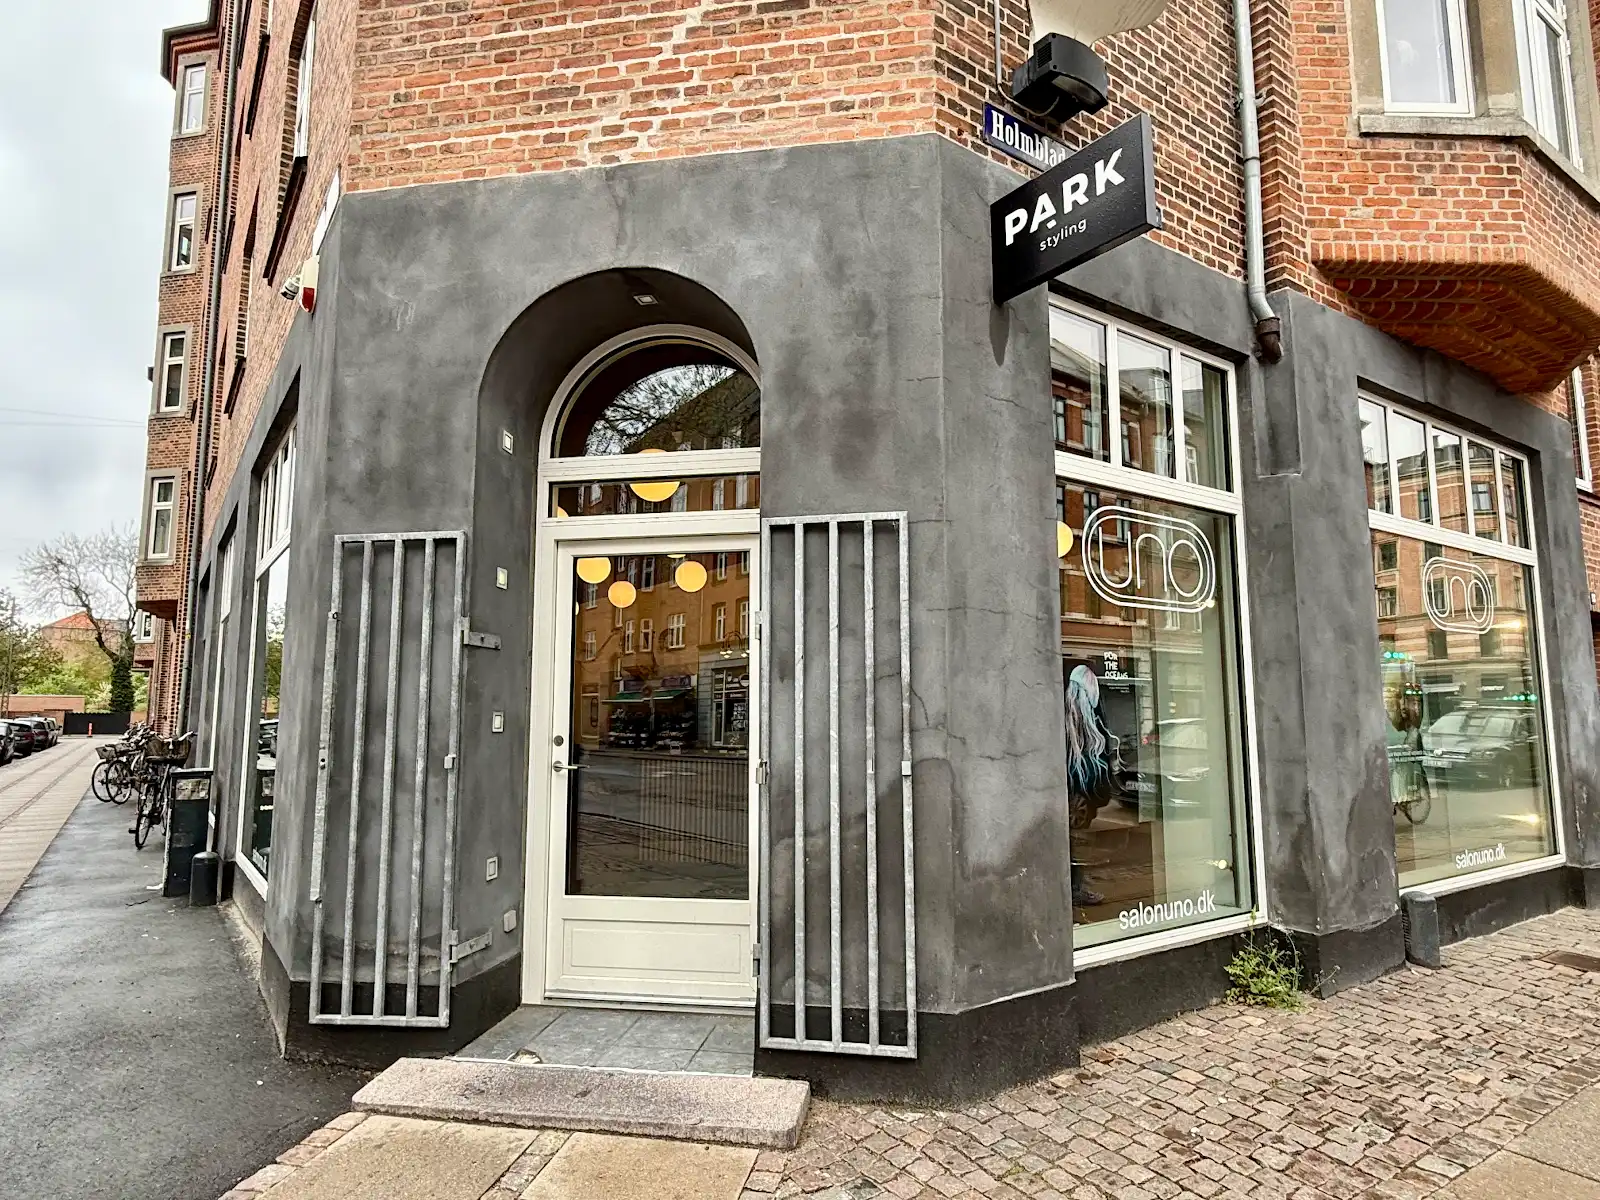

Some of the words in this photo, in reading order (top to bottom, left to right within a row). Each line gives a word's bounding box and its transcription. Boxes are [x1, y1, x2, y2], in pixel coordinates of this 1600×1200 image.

[1004, 147, 1126, 247] PARK
[1039, 218, 1087, 252] styling
[1098, 526, 1204, 598] uno
[1103, 660, 1119, 671] THE
[1455, 842, 1507, 870] salonuno.dk
[1118, 889, 1216, 930] salonuno.dk
